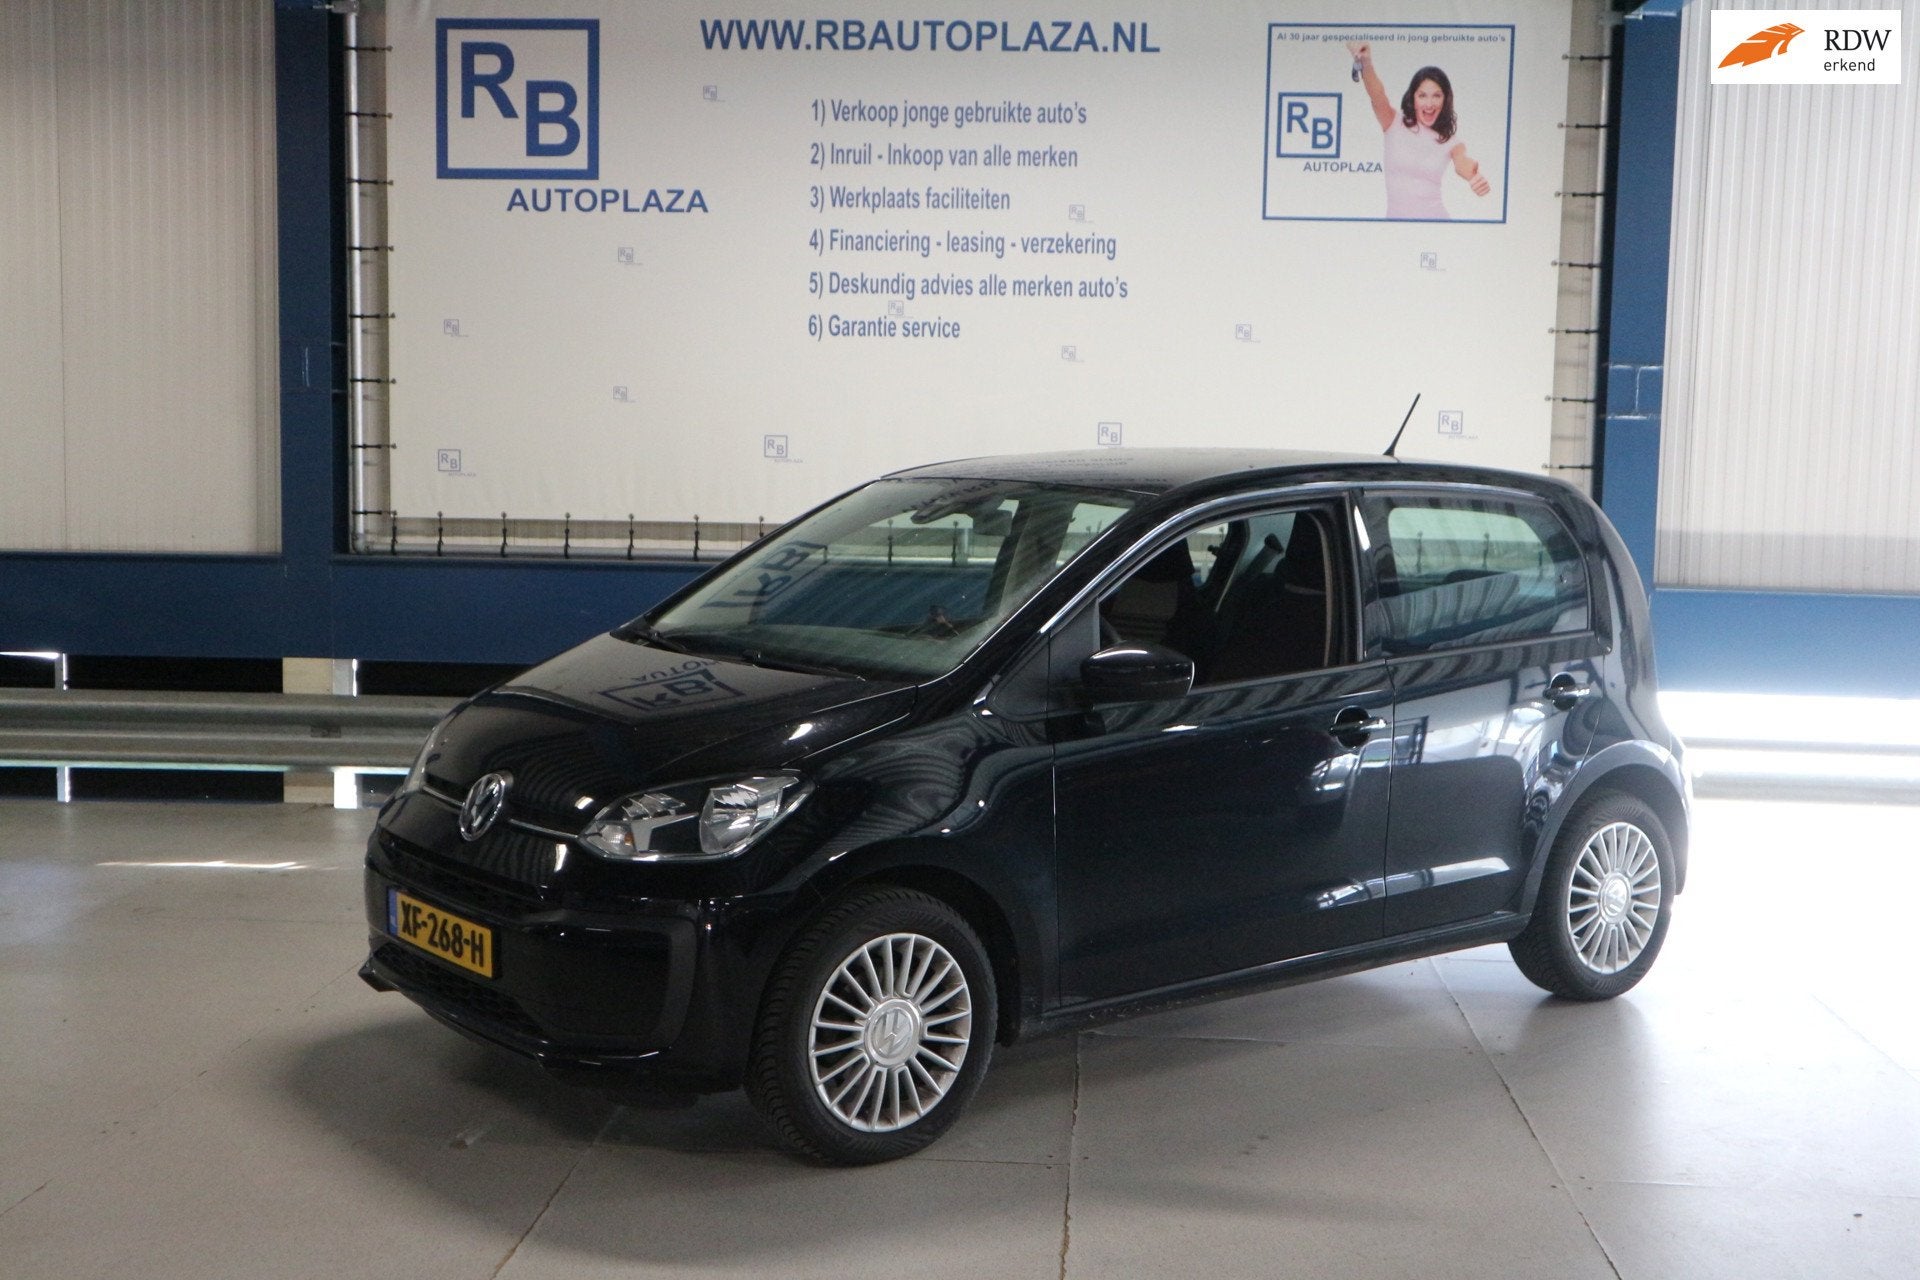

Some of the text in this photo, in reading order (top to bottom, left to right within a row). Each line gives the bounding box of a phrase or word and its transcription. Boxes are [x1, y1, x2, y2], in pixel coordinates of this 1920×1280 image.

[700, 19, 1160, 53] WWW.RBAUTOPLAZA.NL
[1290, 33, 1300, 41] 30
[1302, 33, 1320, 42] jaar
[1322, 33, 1395, 42] gespecialiseerd
[1408, 34, 1429, 43] jong
[1431, 34, 1475, 43] gebruikte
[811, 99, 1087, 129] 1) Verkoop jonge gebruikte auto's
[810, 142, 825, 170] 2)
[830, 142, 872, 166] Inruil
[887, 143, 944, 171] Inkoop
[949, 149, 978, 166] van
[983, 145, 1012, 167] alle
[1017, 145, 1078, 168] merken
[1302, 161, 1383, 173] AUTOPLAZA
[507, 188, 709, 214] AUTOPLAZA
[810, 185, 1011, 214] 3) Werkplaats faciliteiten
[809, 228, 824, 257] 4)
[829, 229, 931, 258] Financiering
[946, 231, 1005, 260] leasing
[1021, 232, 1117, 261] verzekering
[809, 271, 1129, 300] 5) Deskundig advies alle merken auto's
[808, 314, 961, 342] 6) Garantie service
[401, 900, 485, 968] XF-268-H
